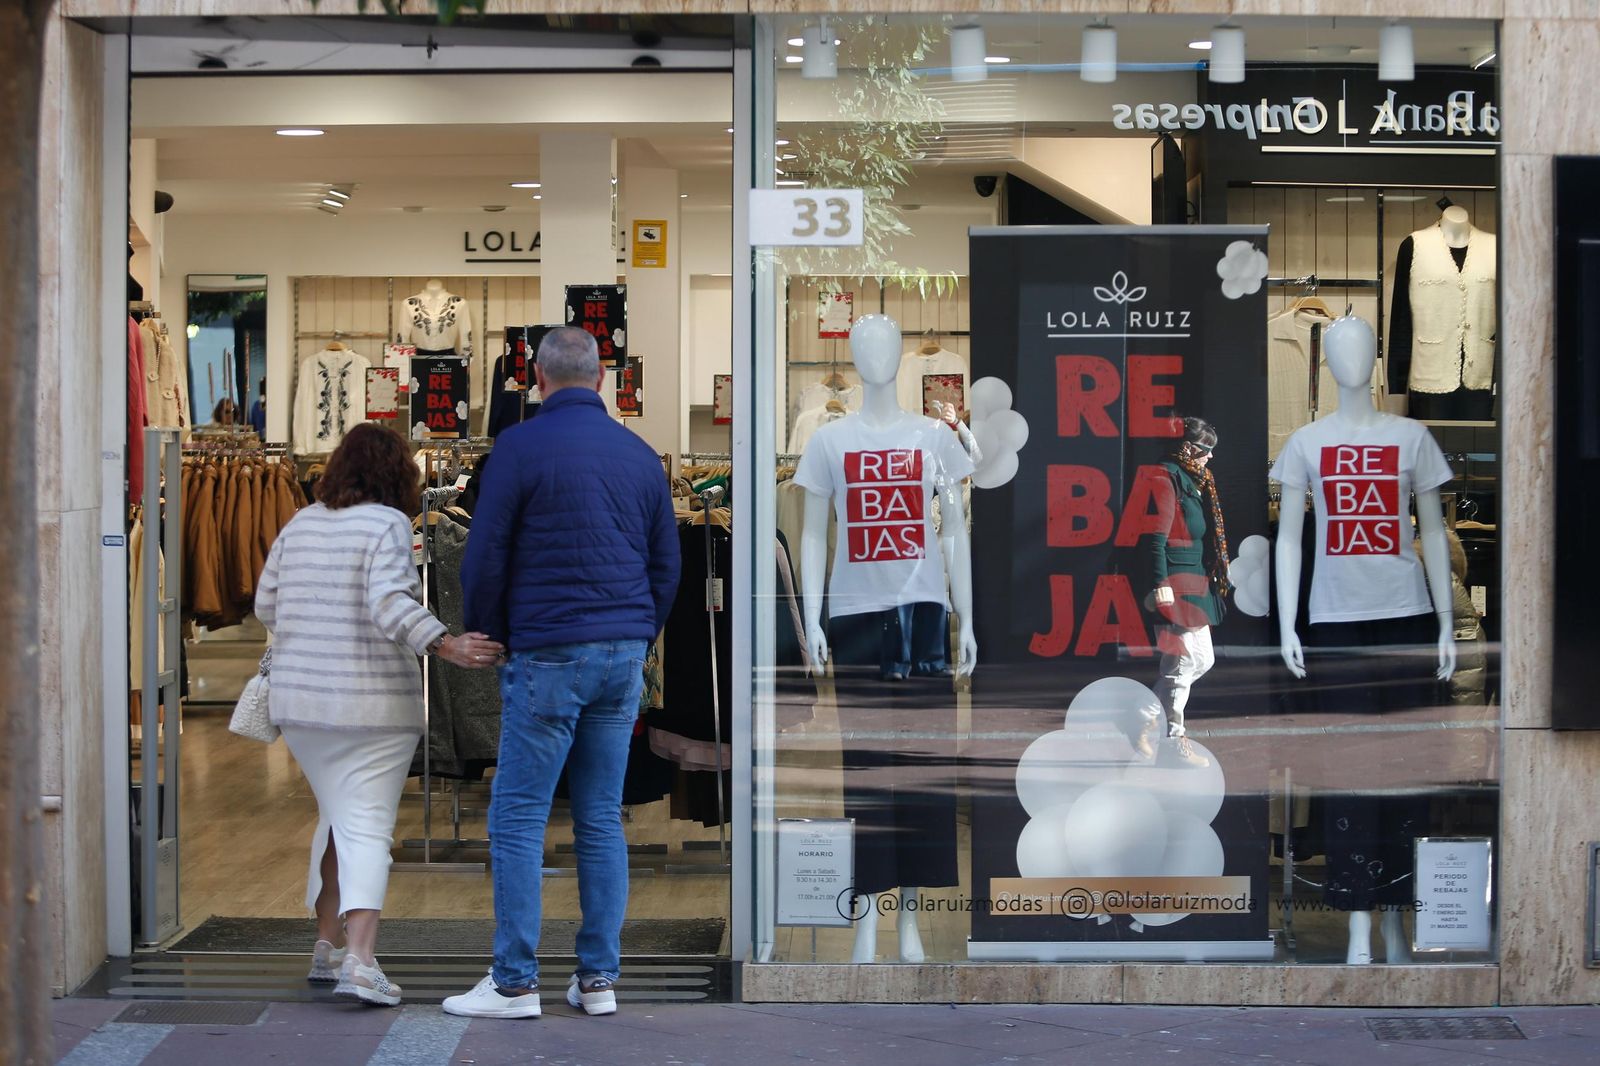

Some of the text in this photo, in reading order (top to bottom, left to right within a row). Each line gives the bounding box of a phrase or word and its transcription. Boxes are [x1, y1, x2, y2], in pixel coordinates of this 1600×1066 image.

[1261, 98, 1403, 135] LOLA
[792, 197, 852, 237] 33
[584, 302, 608, 318] RE
[1047, 311, 1191, 328] LOLA RUIZ
[428, 374, 453, 390] RE
[1056, 355, 1185, 438] RE
[427, 393, 453, 409] BA
[425, 412, 457, 428] JAS
[859, 451, 908, 480] RE
[1335, 446, 1384, 474] RE
[860, 488, 912, 520] BA
[1046, 464, 1193, 548] BA
[1335, 482, 1387, 514] BA
[854, 526, 919, 560] JAS
[1330, 522, 1394, 553] JAS
[1028, 573, 1210, 658] JAS
[876, 893, 1043, 916] @lolaruizmodas
